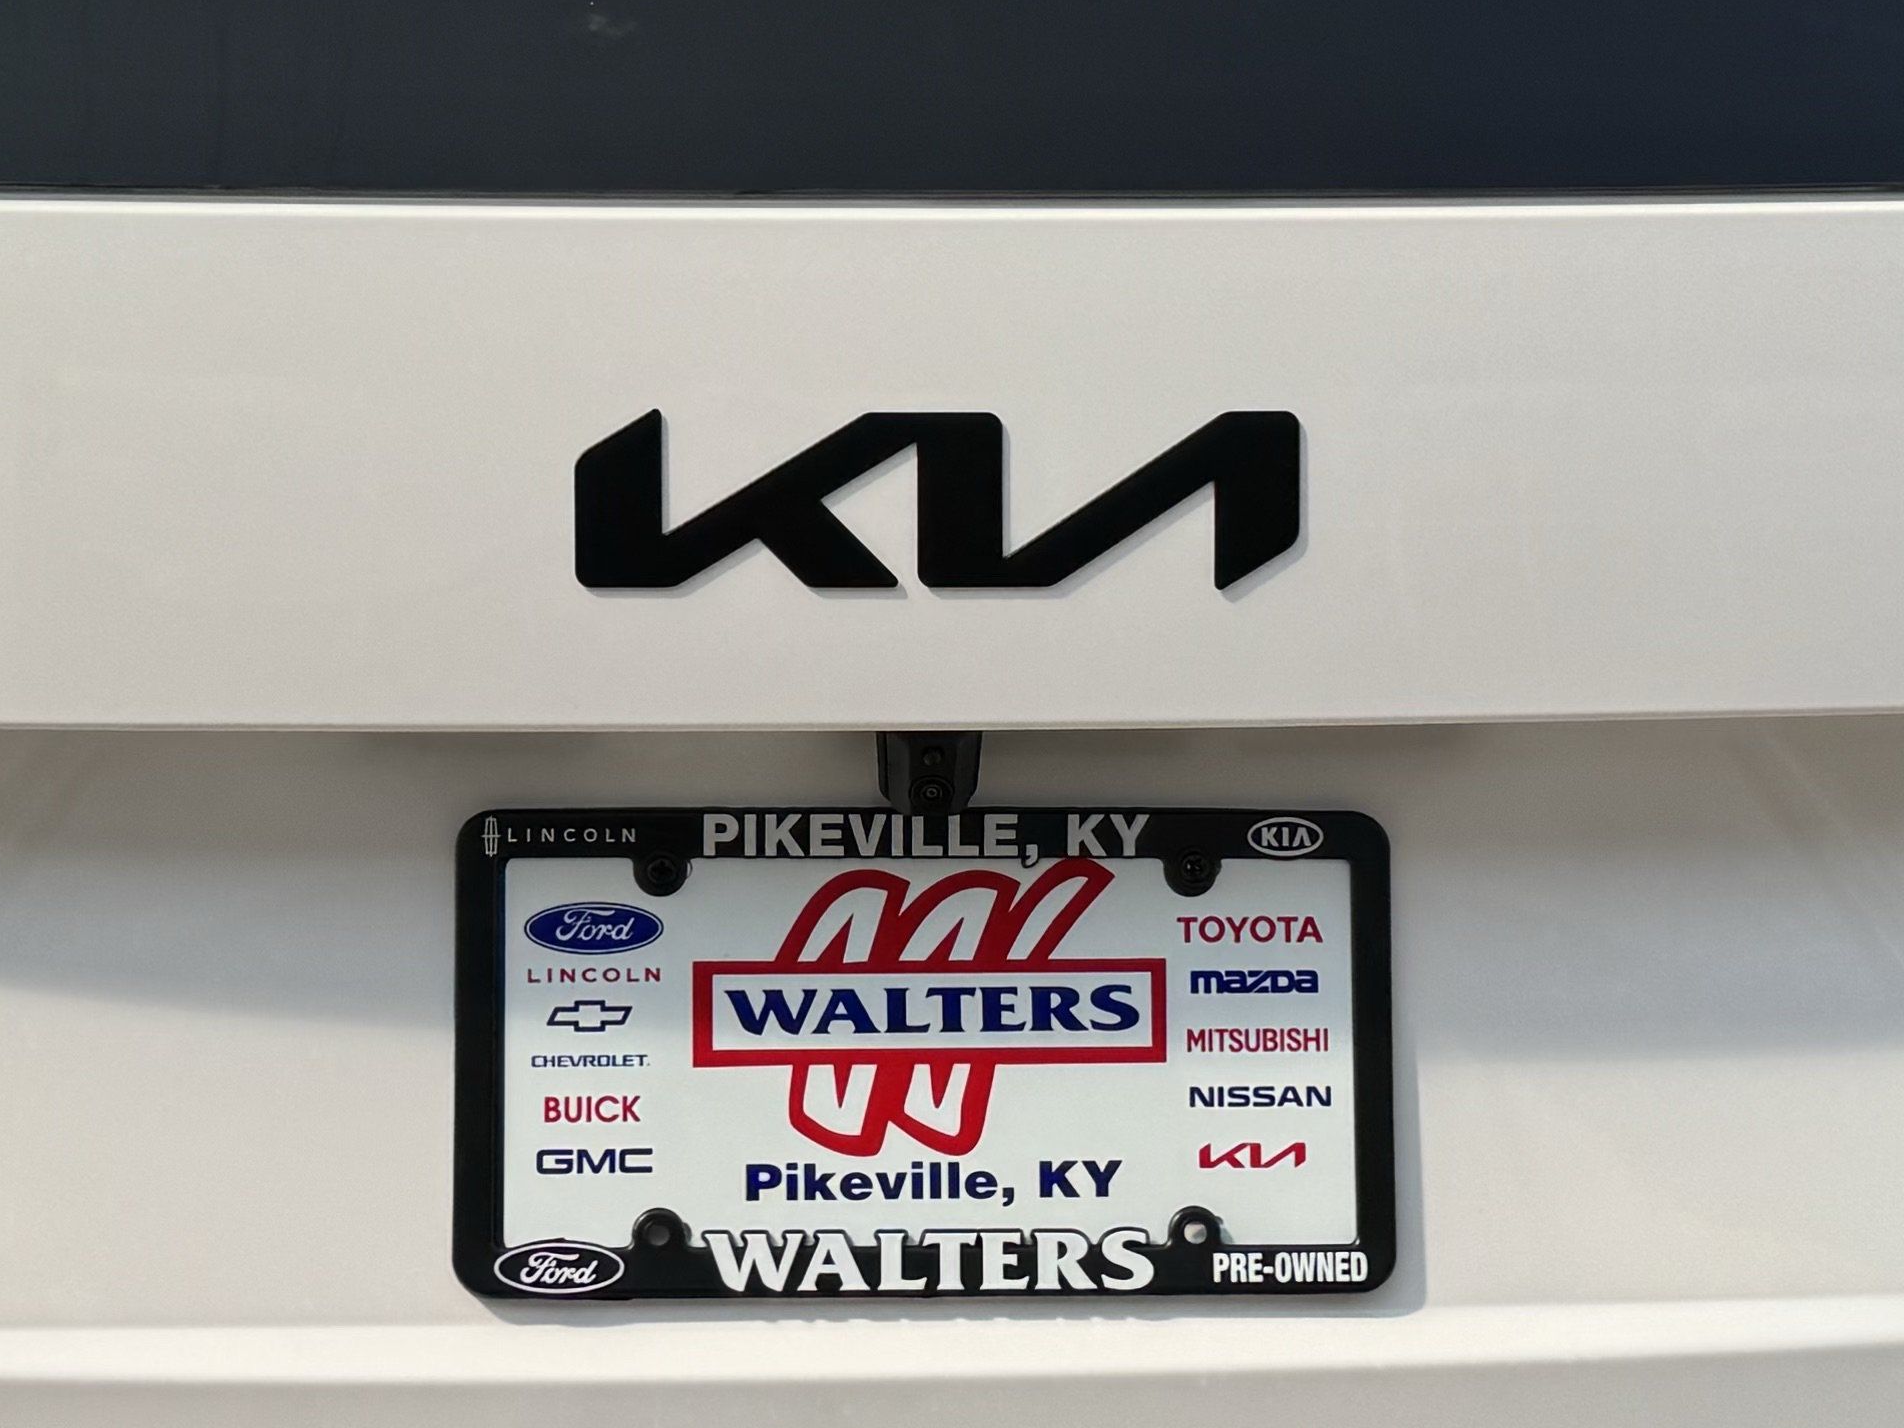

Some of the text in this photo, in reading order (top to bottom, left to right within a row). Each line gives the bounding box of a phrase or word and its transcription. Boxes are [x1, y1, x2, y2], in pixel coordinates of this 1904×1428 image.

[574, 408, 1300, 590] KIA
[507, 827, 636, 843] LINCOLN
[702, 813, 1151, 867] PIKEVILLE, KY
[1261, 826, 1312, 847] KIA
[555, 908, 635, 941] Ford
[1176, 915, 1324, 943] TOYOTA
[527, 967, 662, 983] LINCOLN
[724, 984, 1140, 1036] WALTERS
[1186, 1028, 1329, 1053] MITSUBISHI
[544, 1095, 641, 1123] BUICK
[1189, 1086, 1332, 1108] NISSAN
[536, 1148, 653, 1174] GMC
[745, 1160, 1123, 1207] Pikeville, KY
[520, 1251, 599, 1285] Ford
[702, 1229, 1156, 1292] WALTERS
[1212, 1251, 1369, 1284] PRE-OWNED
